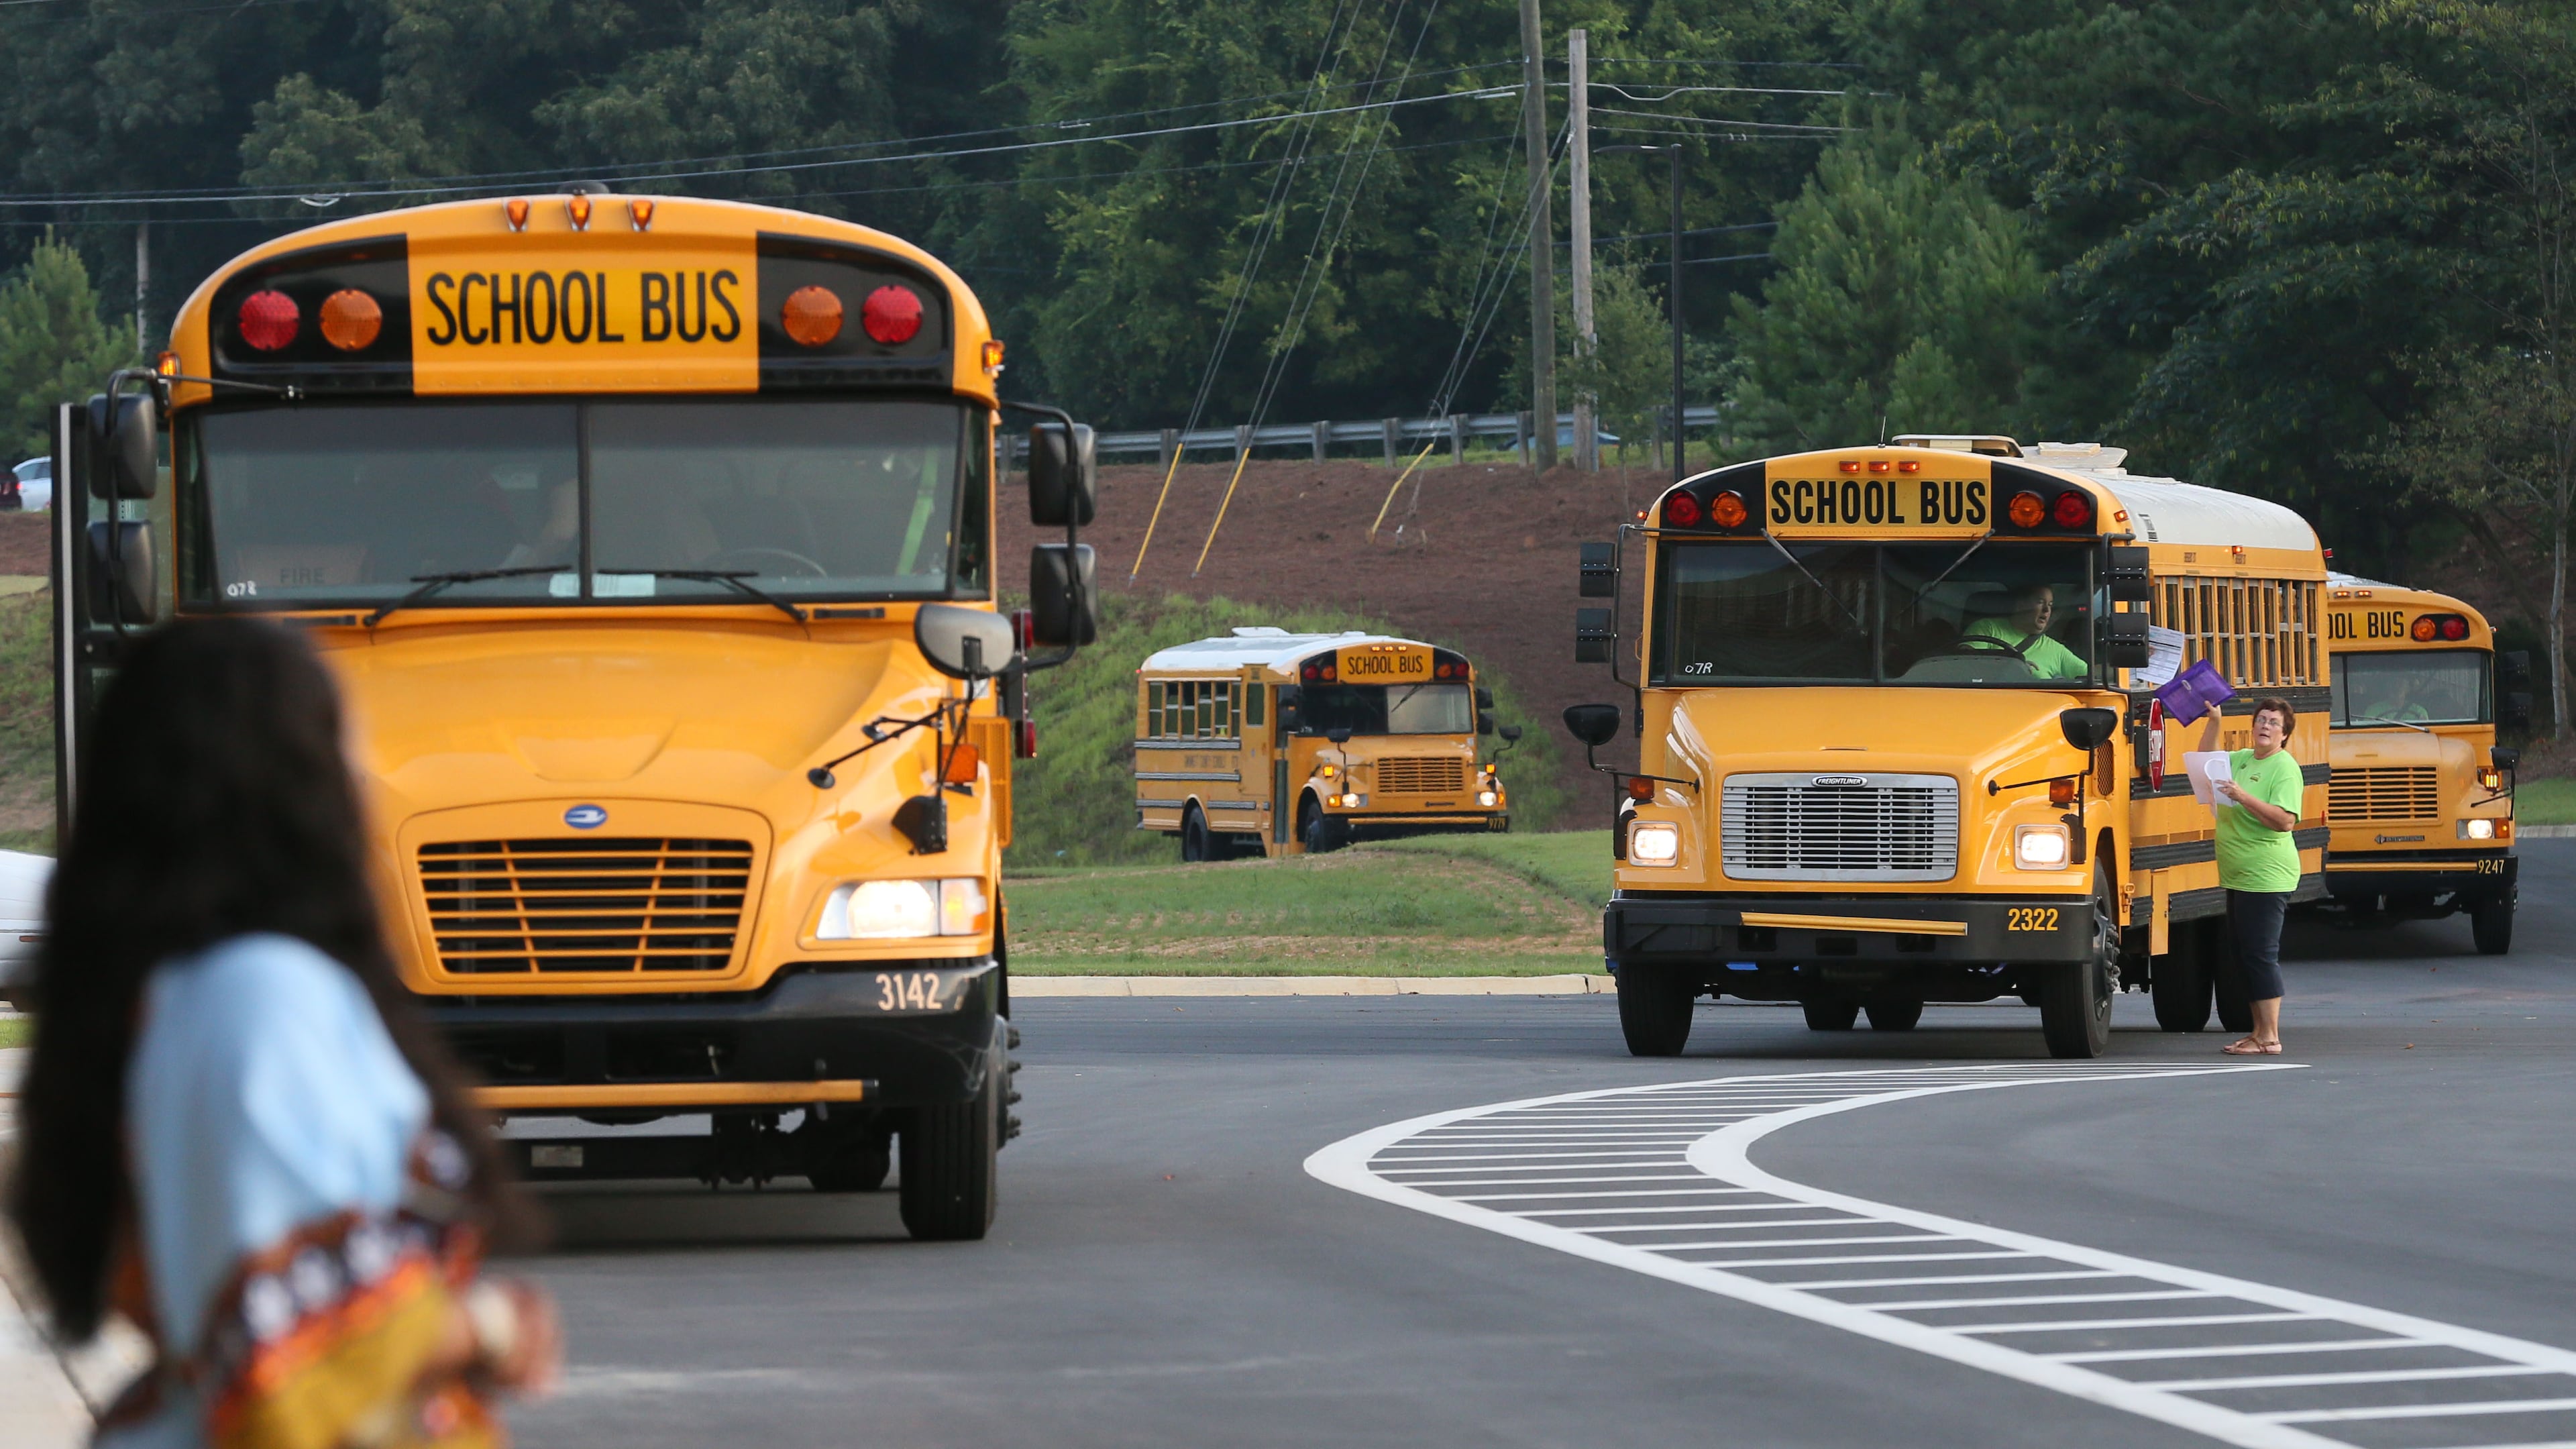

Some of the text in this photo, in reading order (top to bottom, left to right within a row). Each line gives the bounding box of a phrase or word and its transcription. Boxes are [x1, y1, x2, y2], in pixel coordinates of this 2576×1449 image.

[427, 270, 741, 345] SCHOOL BUS
[1771, 480, 1986, 525] SCHOOL BUS
[280, 568, 325, 584] FIRE
[2367, 610, 2404, 638] BUS
[1348, 655, 1423, 675] SCHOOL BUS
[2478, 859, 2505, 874] 9247
[2008, 908, 2059, 931] 2322
[875, 973, 943, 1011] 3142
